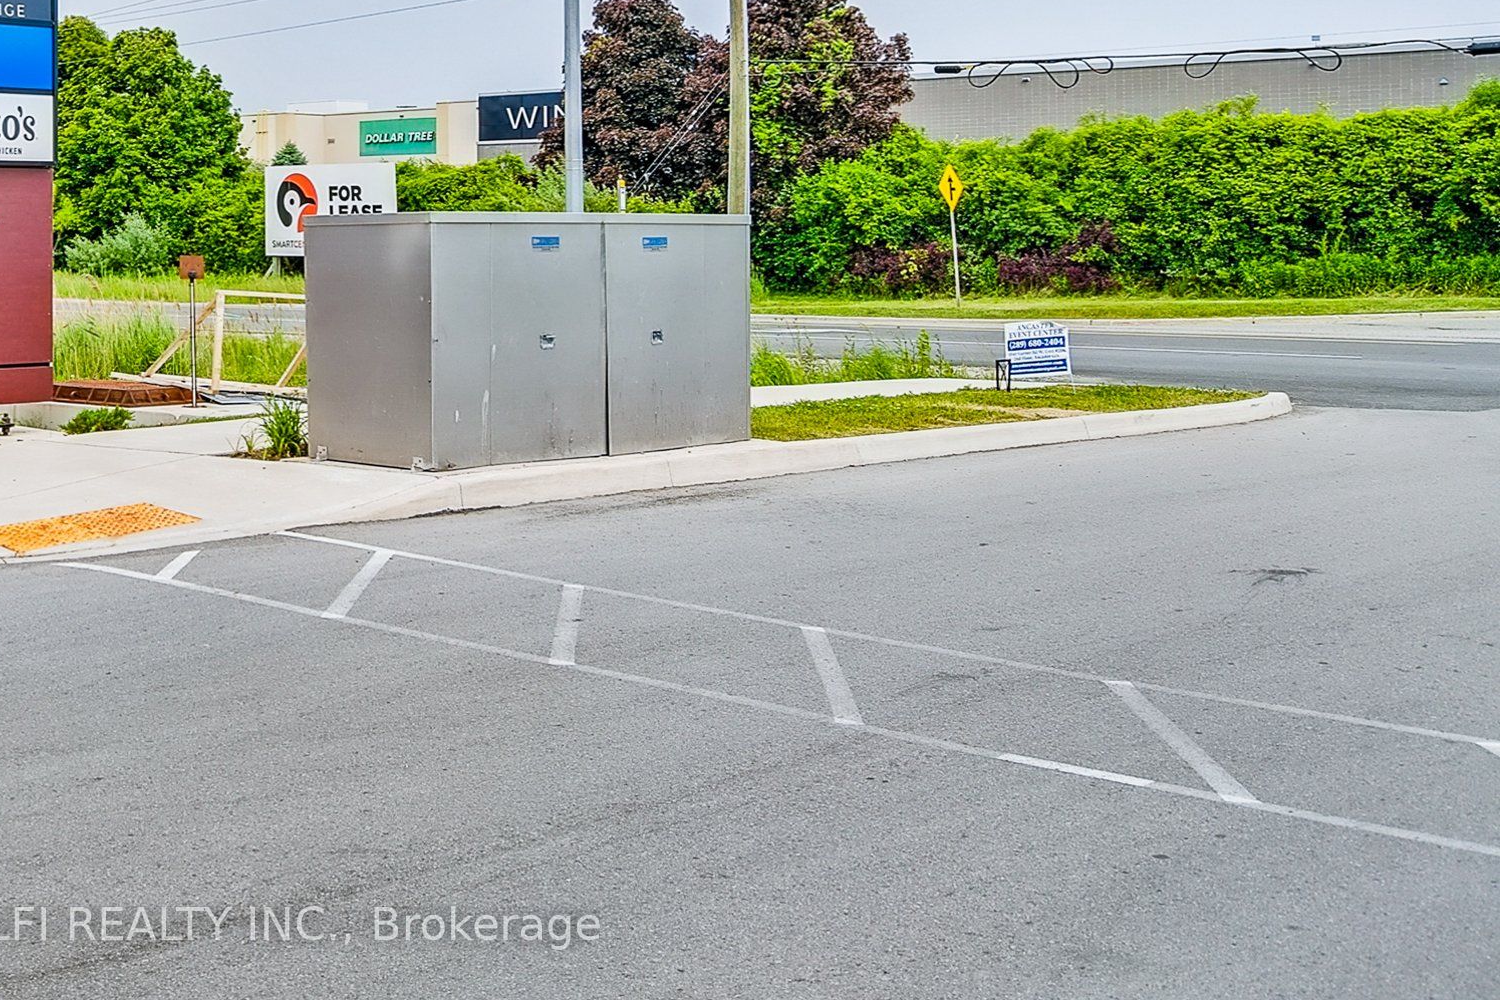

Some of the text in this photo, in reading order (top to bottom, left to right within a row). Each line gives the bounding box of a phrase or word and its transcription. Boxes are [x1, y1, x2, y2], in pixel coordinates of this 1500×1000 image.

[365, 131, 434, 144] DOLLAR TREE
[329, 186, 362, 201] FOR
[272, 240, 304, 248] SMARTCE
[1009, 328, 1064, 338] EVENT CENTER
[1009, 340, 1027, 349] (289)
